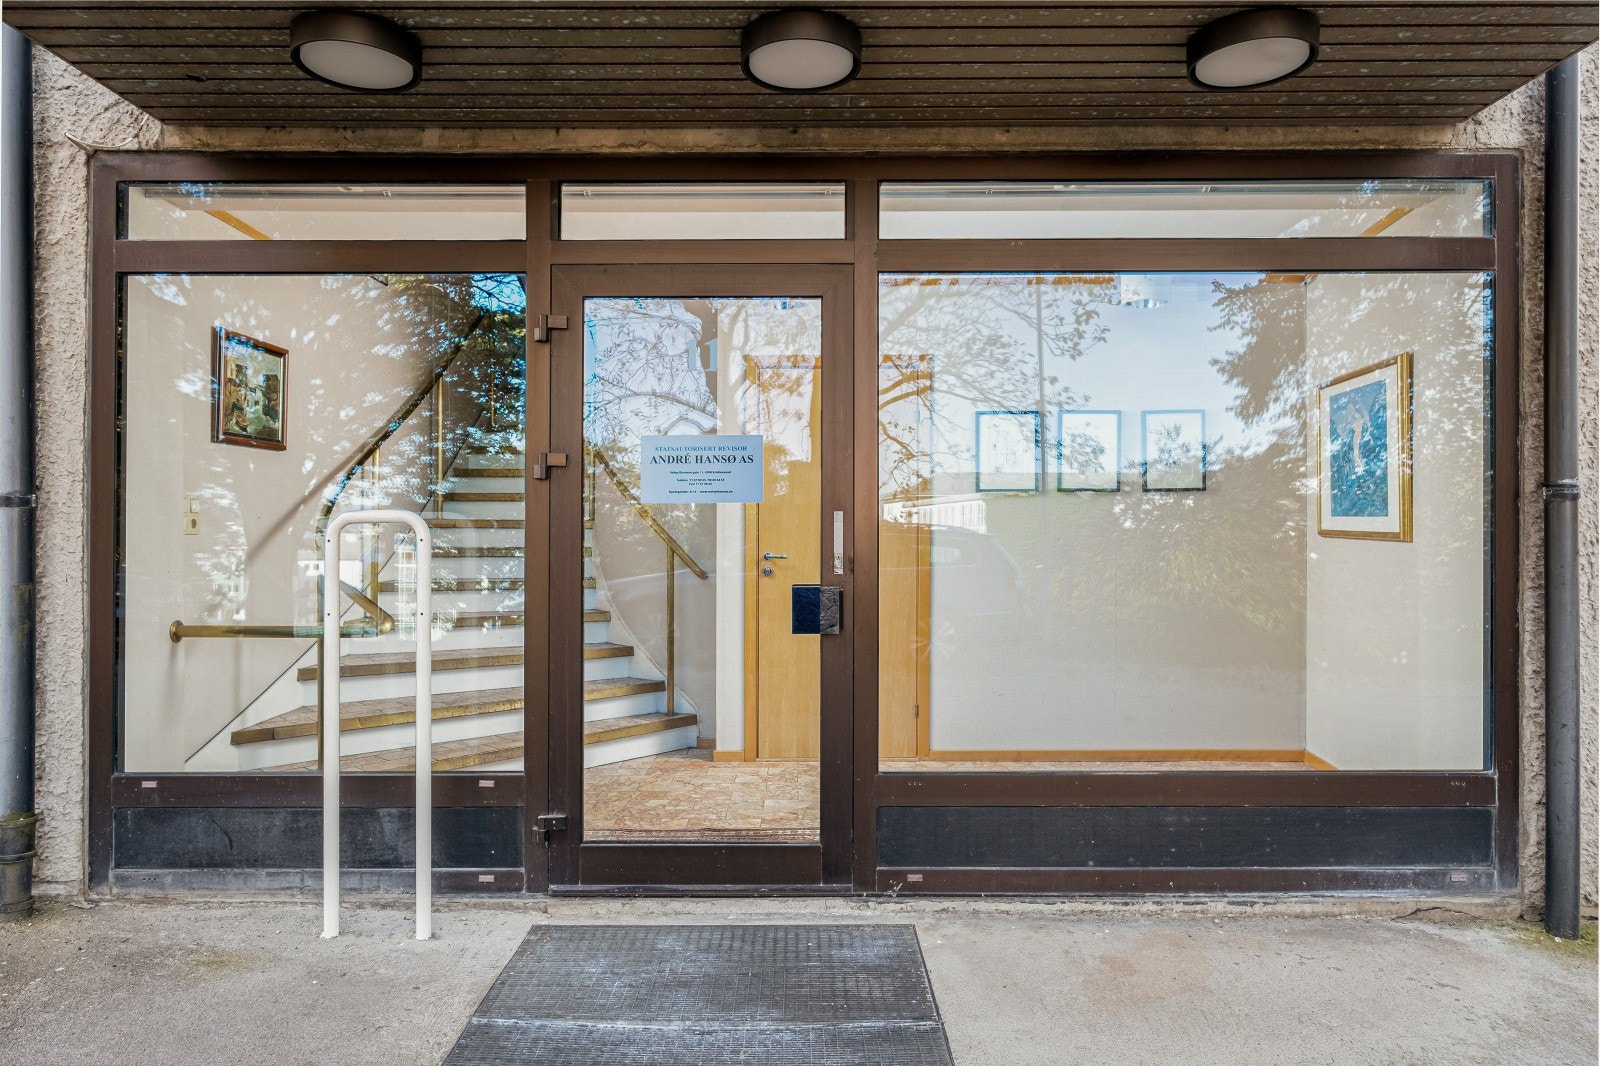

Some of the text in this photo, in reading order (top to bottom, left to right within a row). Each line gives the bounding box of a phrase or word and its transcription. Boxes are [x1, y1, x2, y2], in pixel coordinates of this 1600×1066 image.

[650, 453, 754, 465] ANDRÉ HANSØ AS
